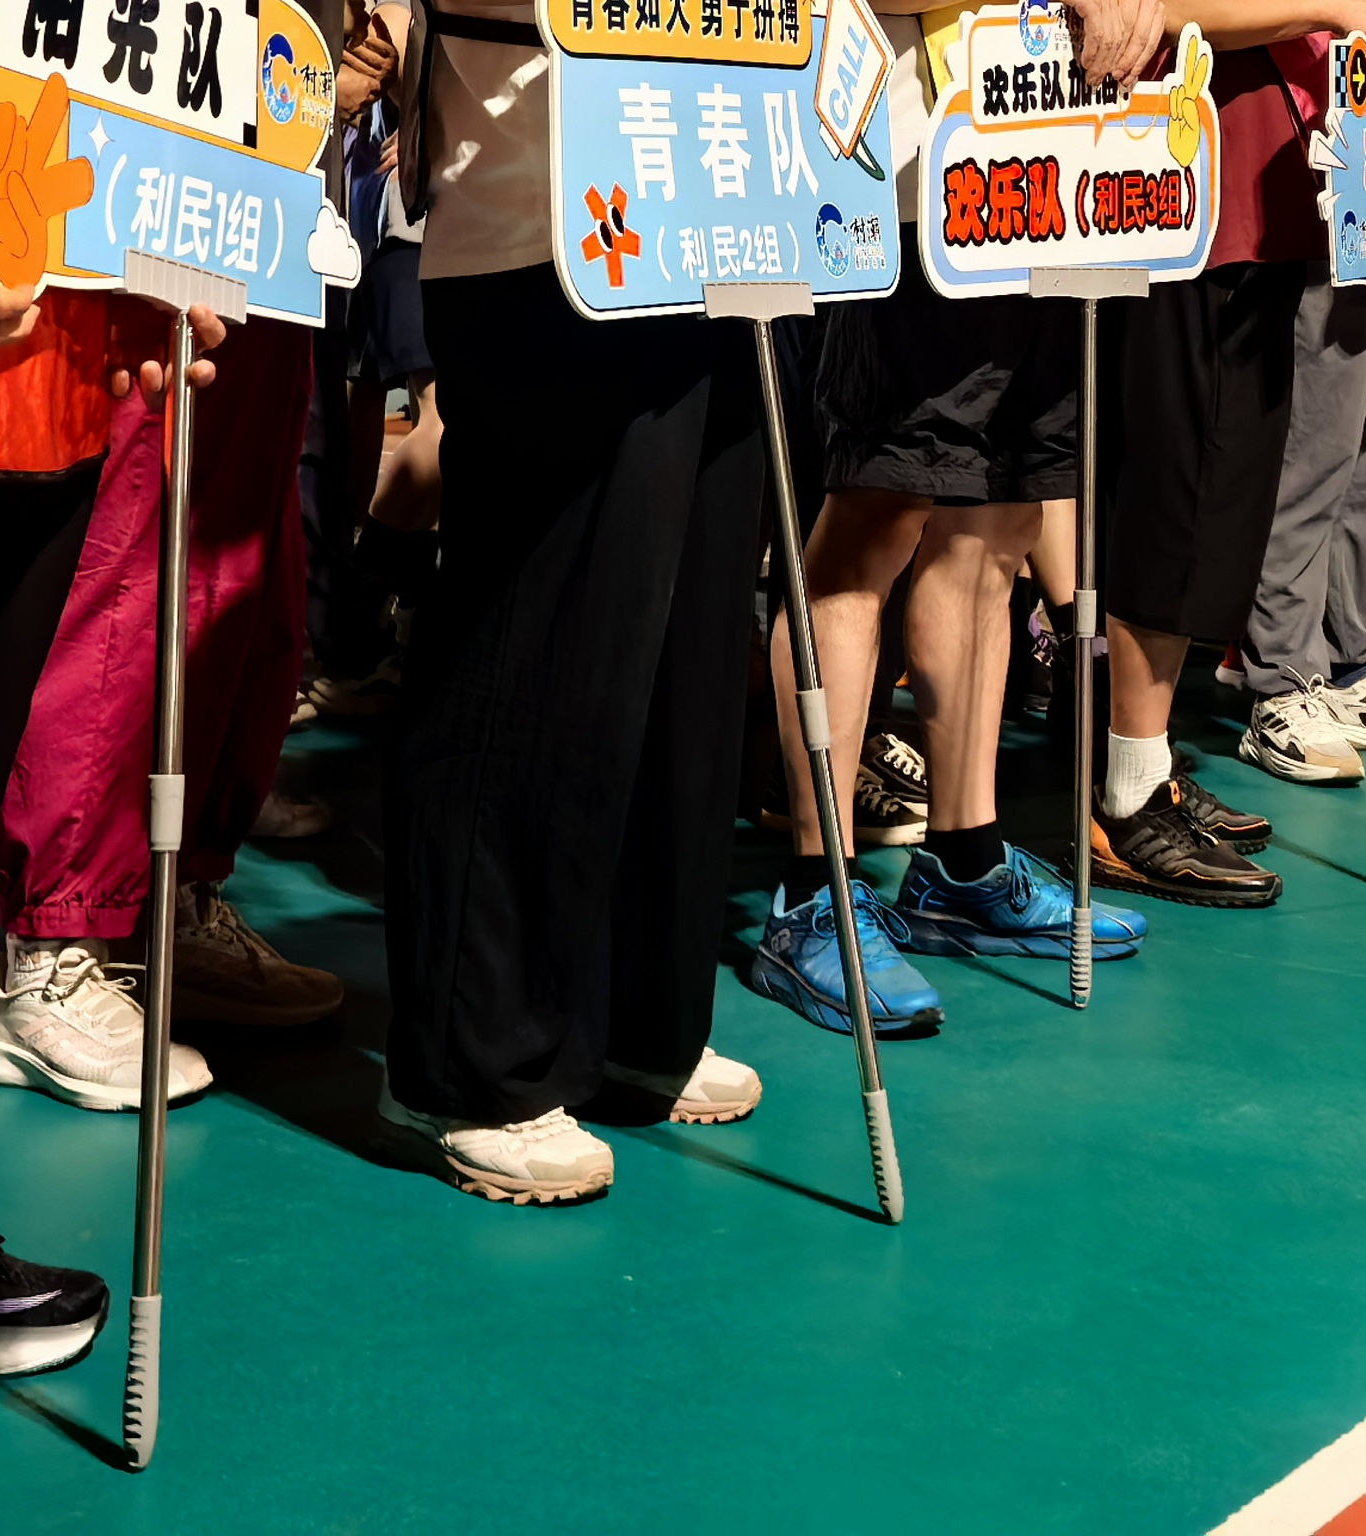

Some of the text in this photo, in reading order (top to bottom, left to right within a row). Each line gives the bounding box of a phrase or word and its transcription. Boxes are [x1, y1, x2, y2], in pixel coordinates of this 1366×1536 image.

[826, 23, 869, 131] CALL
[617, 82, 820, 202] 青春队
[103, 152, 287, 278] （利民1组）
[656, 220, 802, 283] （利民2组）
